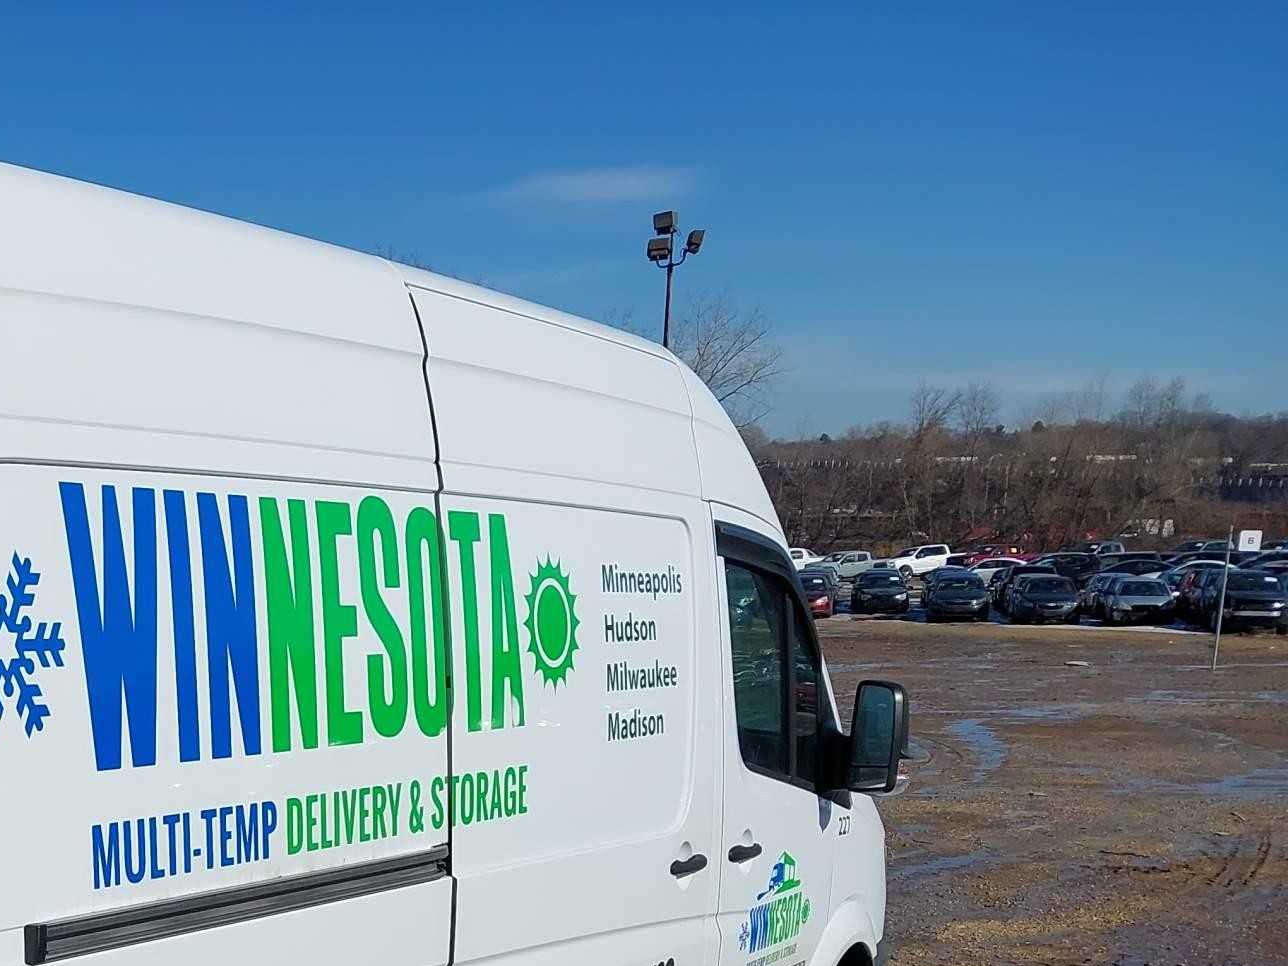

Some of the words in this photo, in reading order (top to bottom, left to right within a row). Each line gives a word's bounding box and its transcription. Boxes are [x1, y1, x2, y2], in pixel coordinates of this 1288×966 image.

[601, 563, 682, 601] Minneapolis
[58, 481, 526, 772] WINNESOTA
[604, 612, 657, 643] Hudson
[606, 658, 678, 693] Milwaukee
[607, 707, 664, 742] Madison
[91, 801, 278, 890] MULTI-TEMP
[286, 783, 402, 856] DELIVERY
[409, 779, 425, 834] &
[430, 765, 529, 831] STORAGE
[838, 815, 851, 836] 227
[749, 891, 803, 955] WINNESOTA
